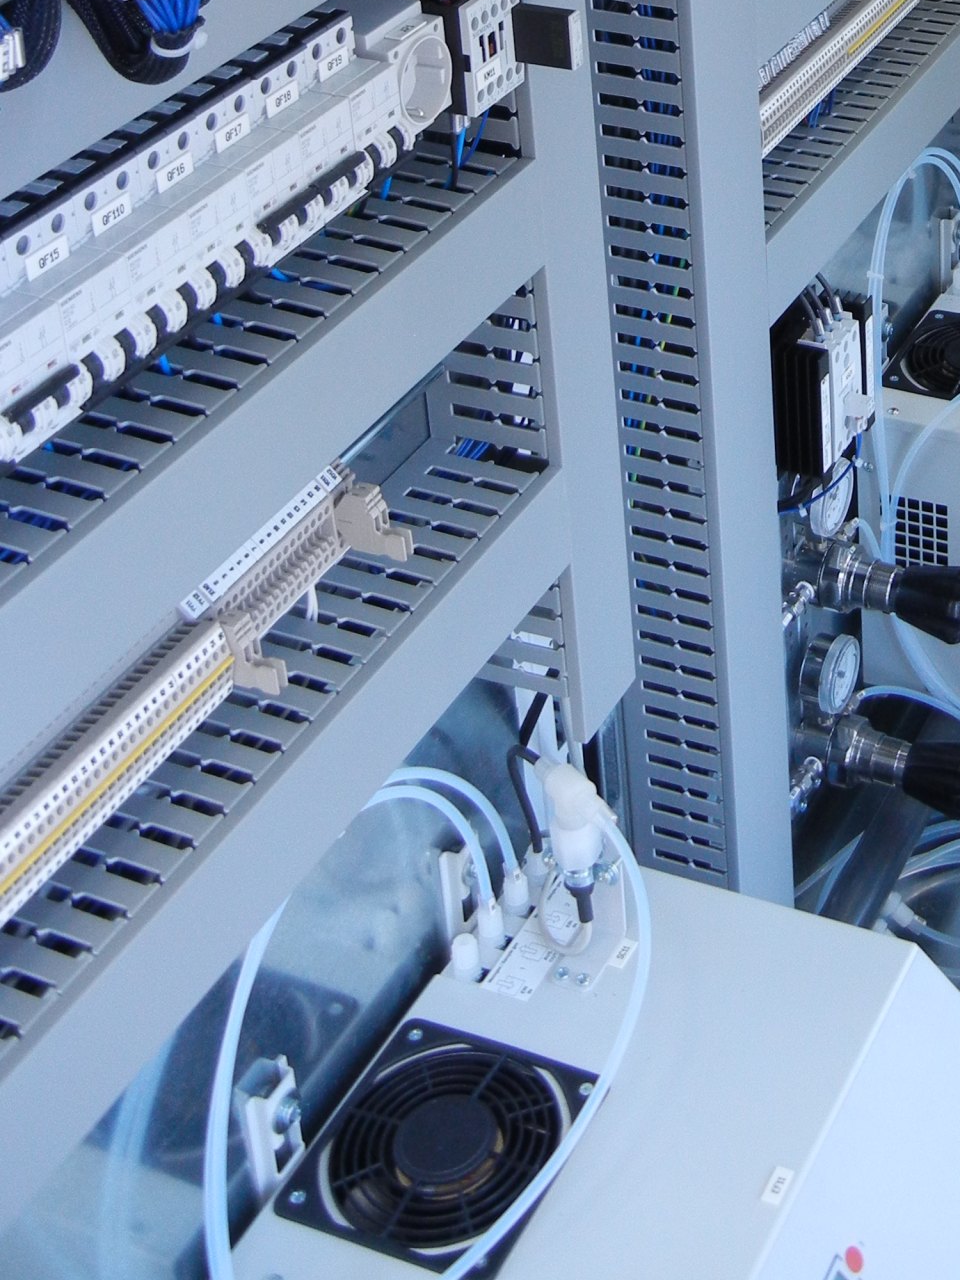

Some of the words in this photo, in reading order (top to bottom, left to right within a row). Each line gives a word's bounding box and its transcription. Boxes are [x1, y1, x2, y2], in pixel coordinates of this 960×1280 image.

[225, 124, 242, 142] QF17
[102, 203, 125, 226] QF110
[38, 249, 60, 269] QF15
